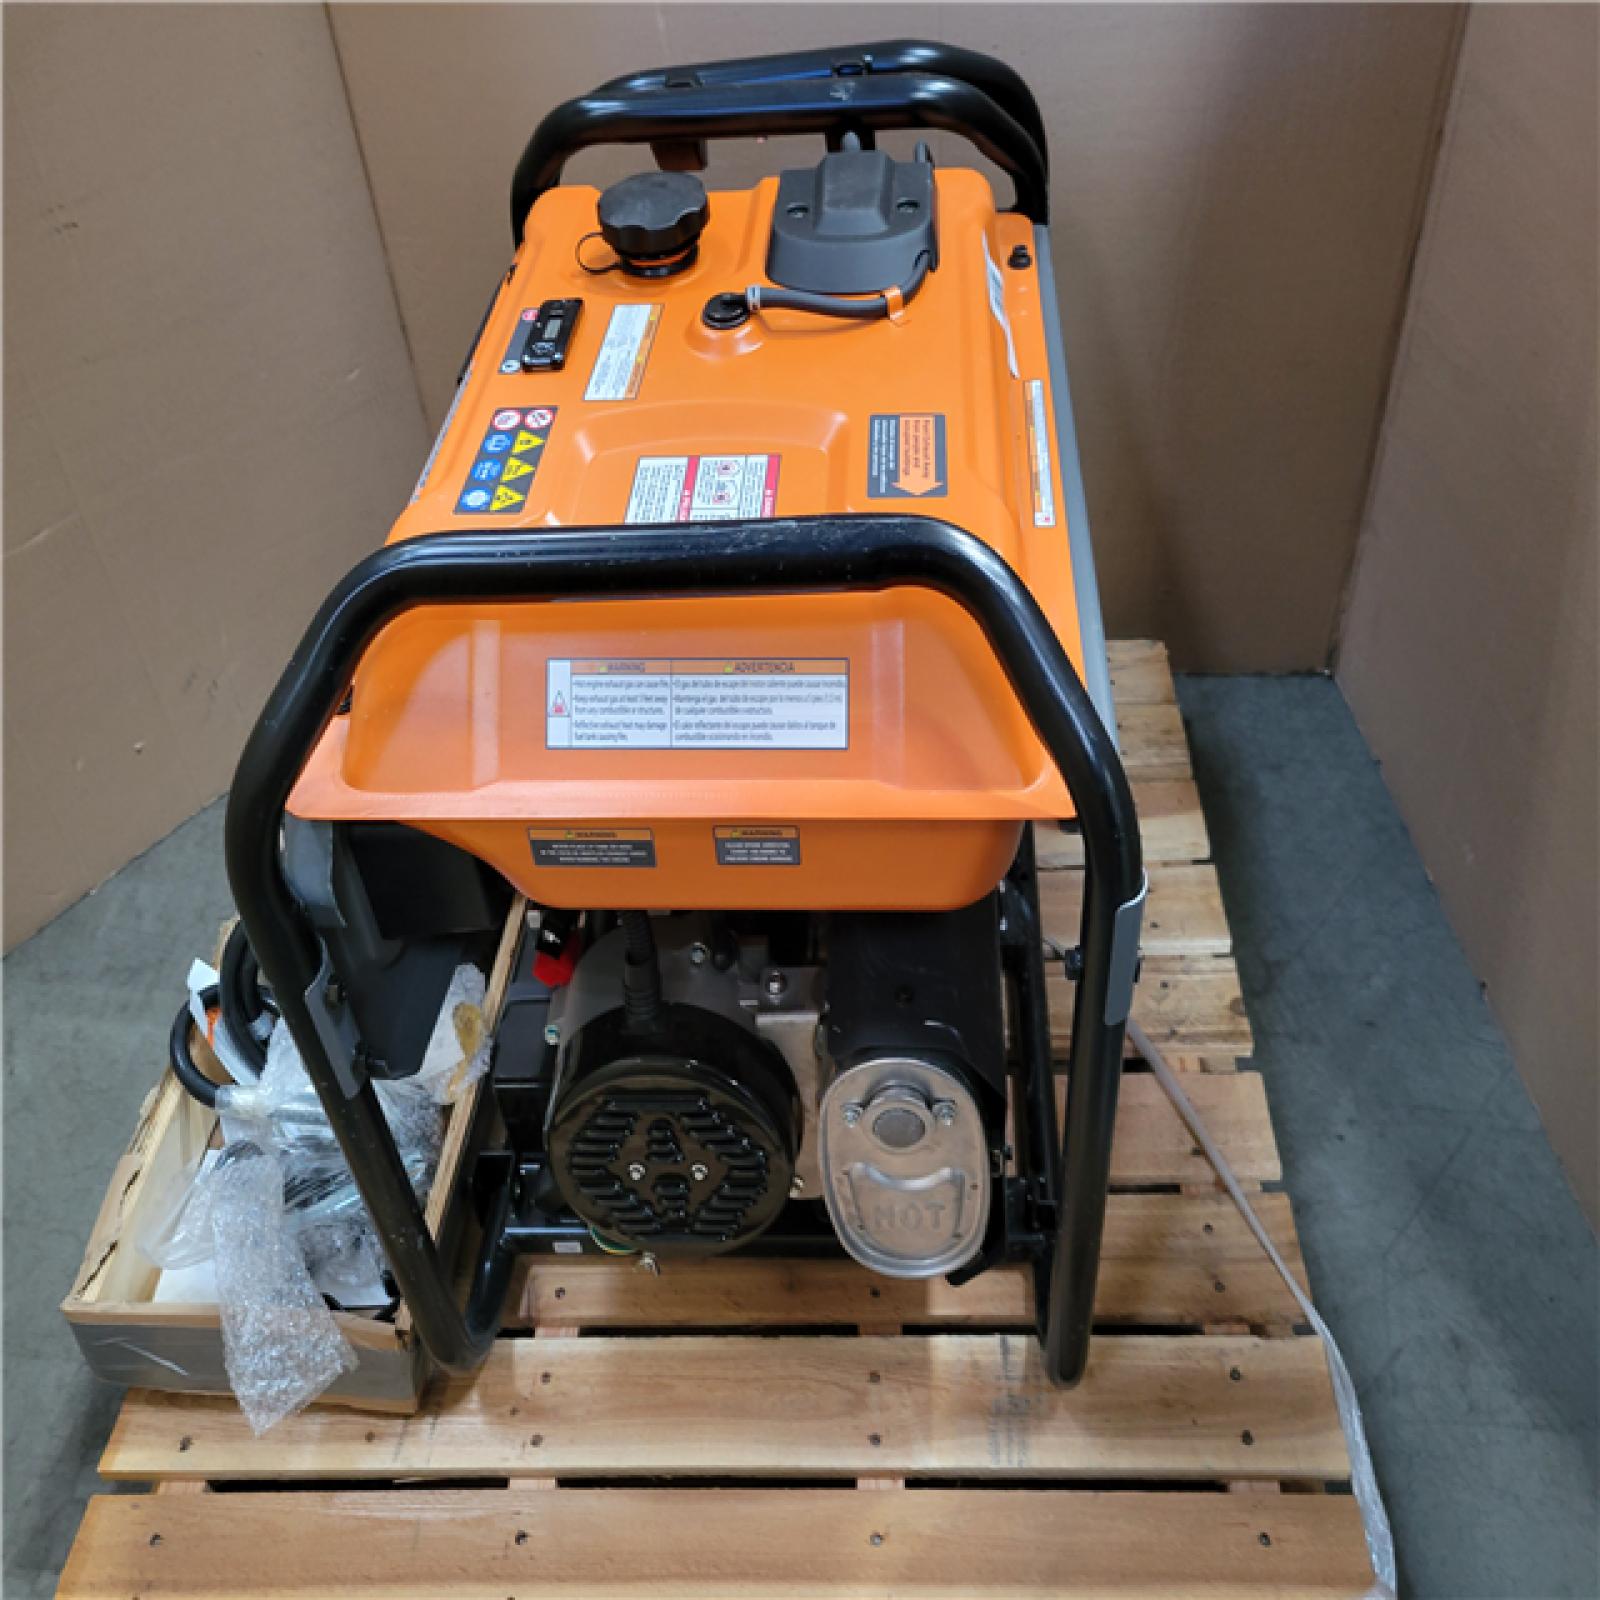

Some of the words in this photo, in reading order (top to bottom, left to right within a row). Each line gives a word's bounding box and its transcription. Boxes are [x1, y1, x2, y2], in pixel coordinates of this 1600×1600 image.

[607, 661, 645, 673] WARNING
[734, 661, 796, 673] ADVERTENCIA
[874, 1201, 946, 1231] HOT
